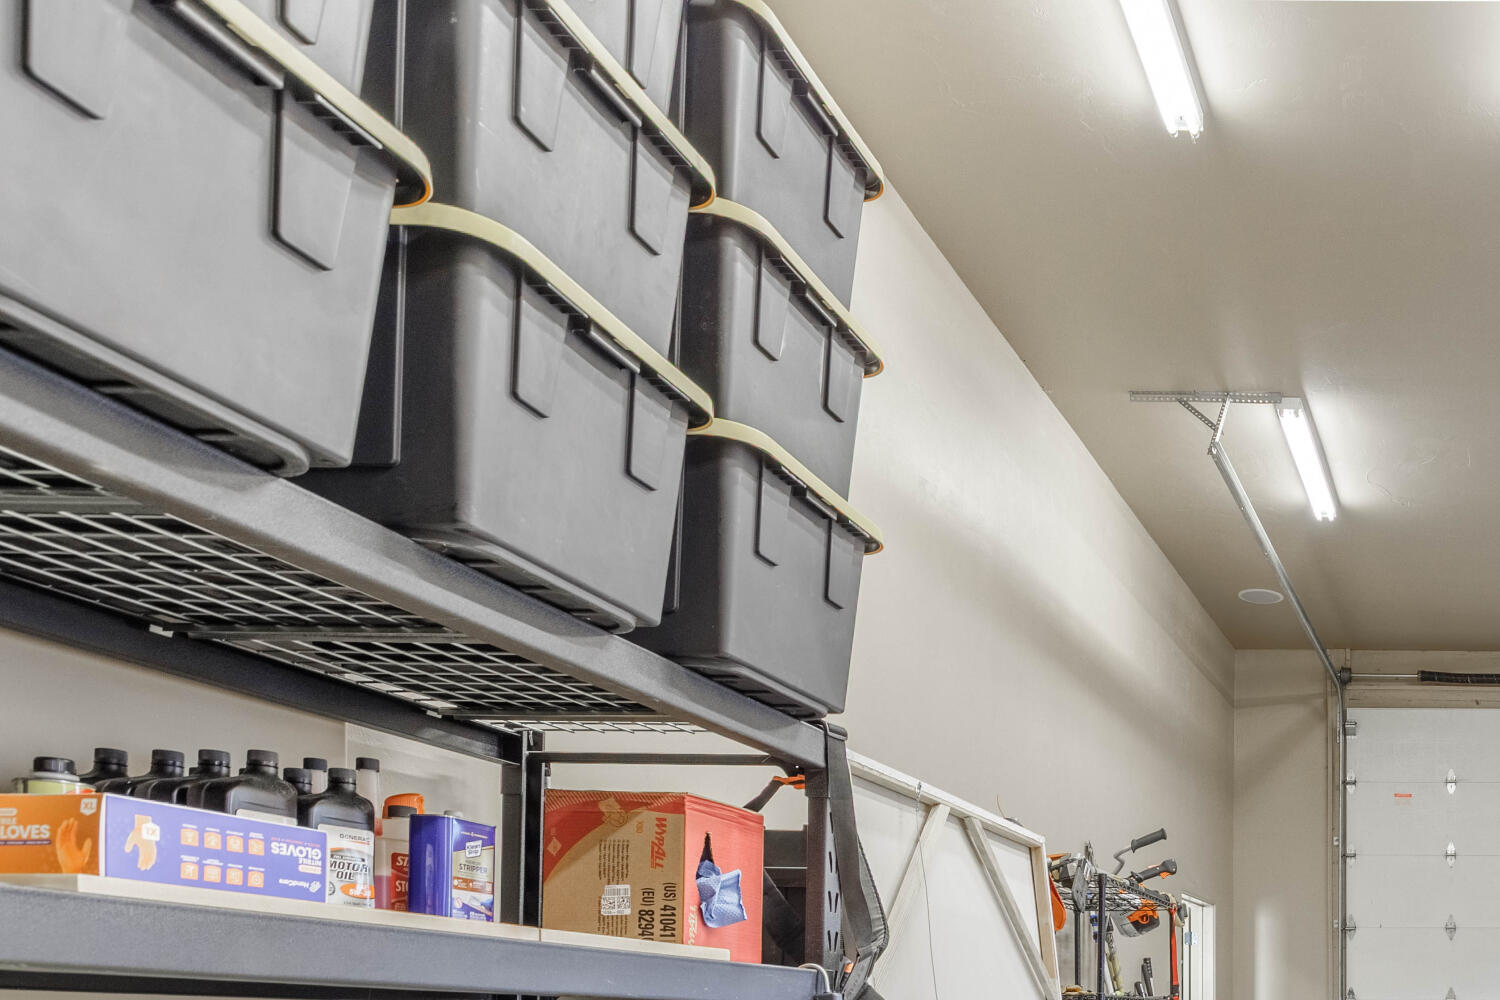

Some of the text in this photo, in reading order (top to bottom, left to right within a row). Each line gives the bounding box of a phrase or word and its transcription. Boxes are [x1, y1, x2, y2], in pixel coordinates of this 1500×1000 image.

[0, 823, 51, 839] LOVES
[270, 841, 322, 861] GLOVES
[336, 870, 355, 880] OIL
[640, 887, 655, 906] (EU)
[659, 882, 678, 938] (US) 41041
